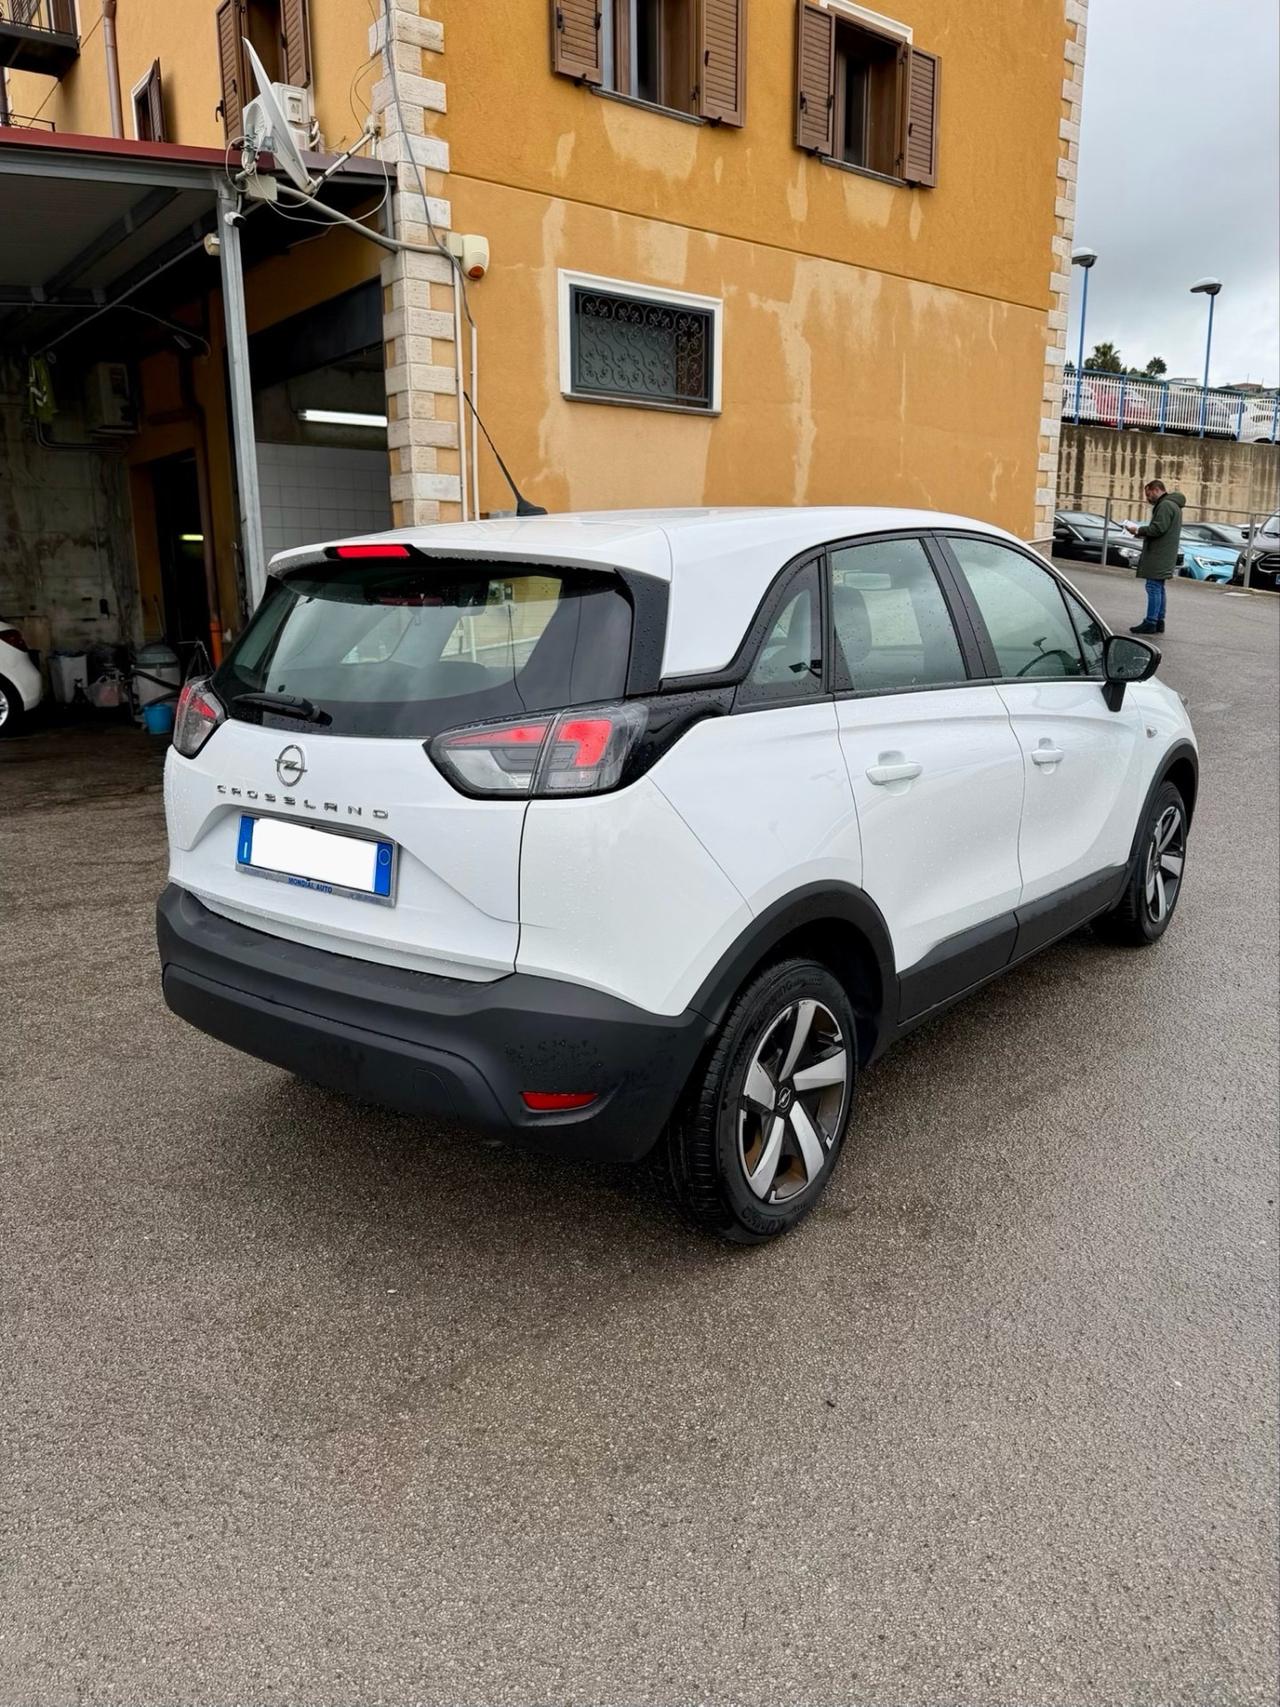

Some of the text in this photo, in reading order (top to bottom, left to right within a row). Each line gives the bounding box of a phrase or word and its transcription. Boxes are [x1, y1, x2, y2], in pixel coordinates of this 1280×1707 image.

[217, 784, 389, 819] CROSSLAND
[288, 877, 333, 894] MONDIAL AUTO
